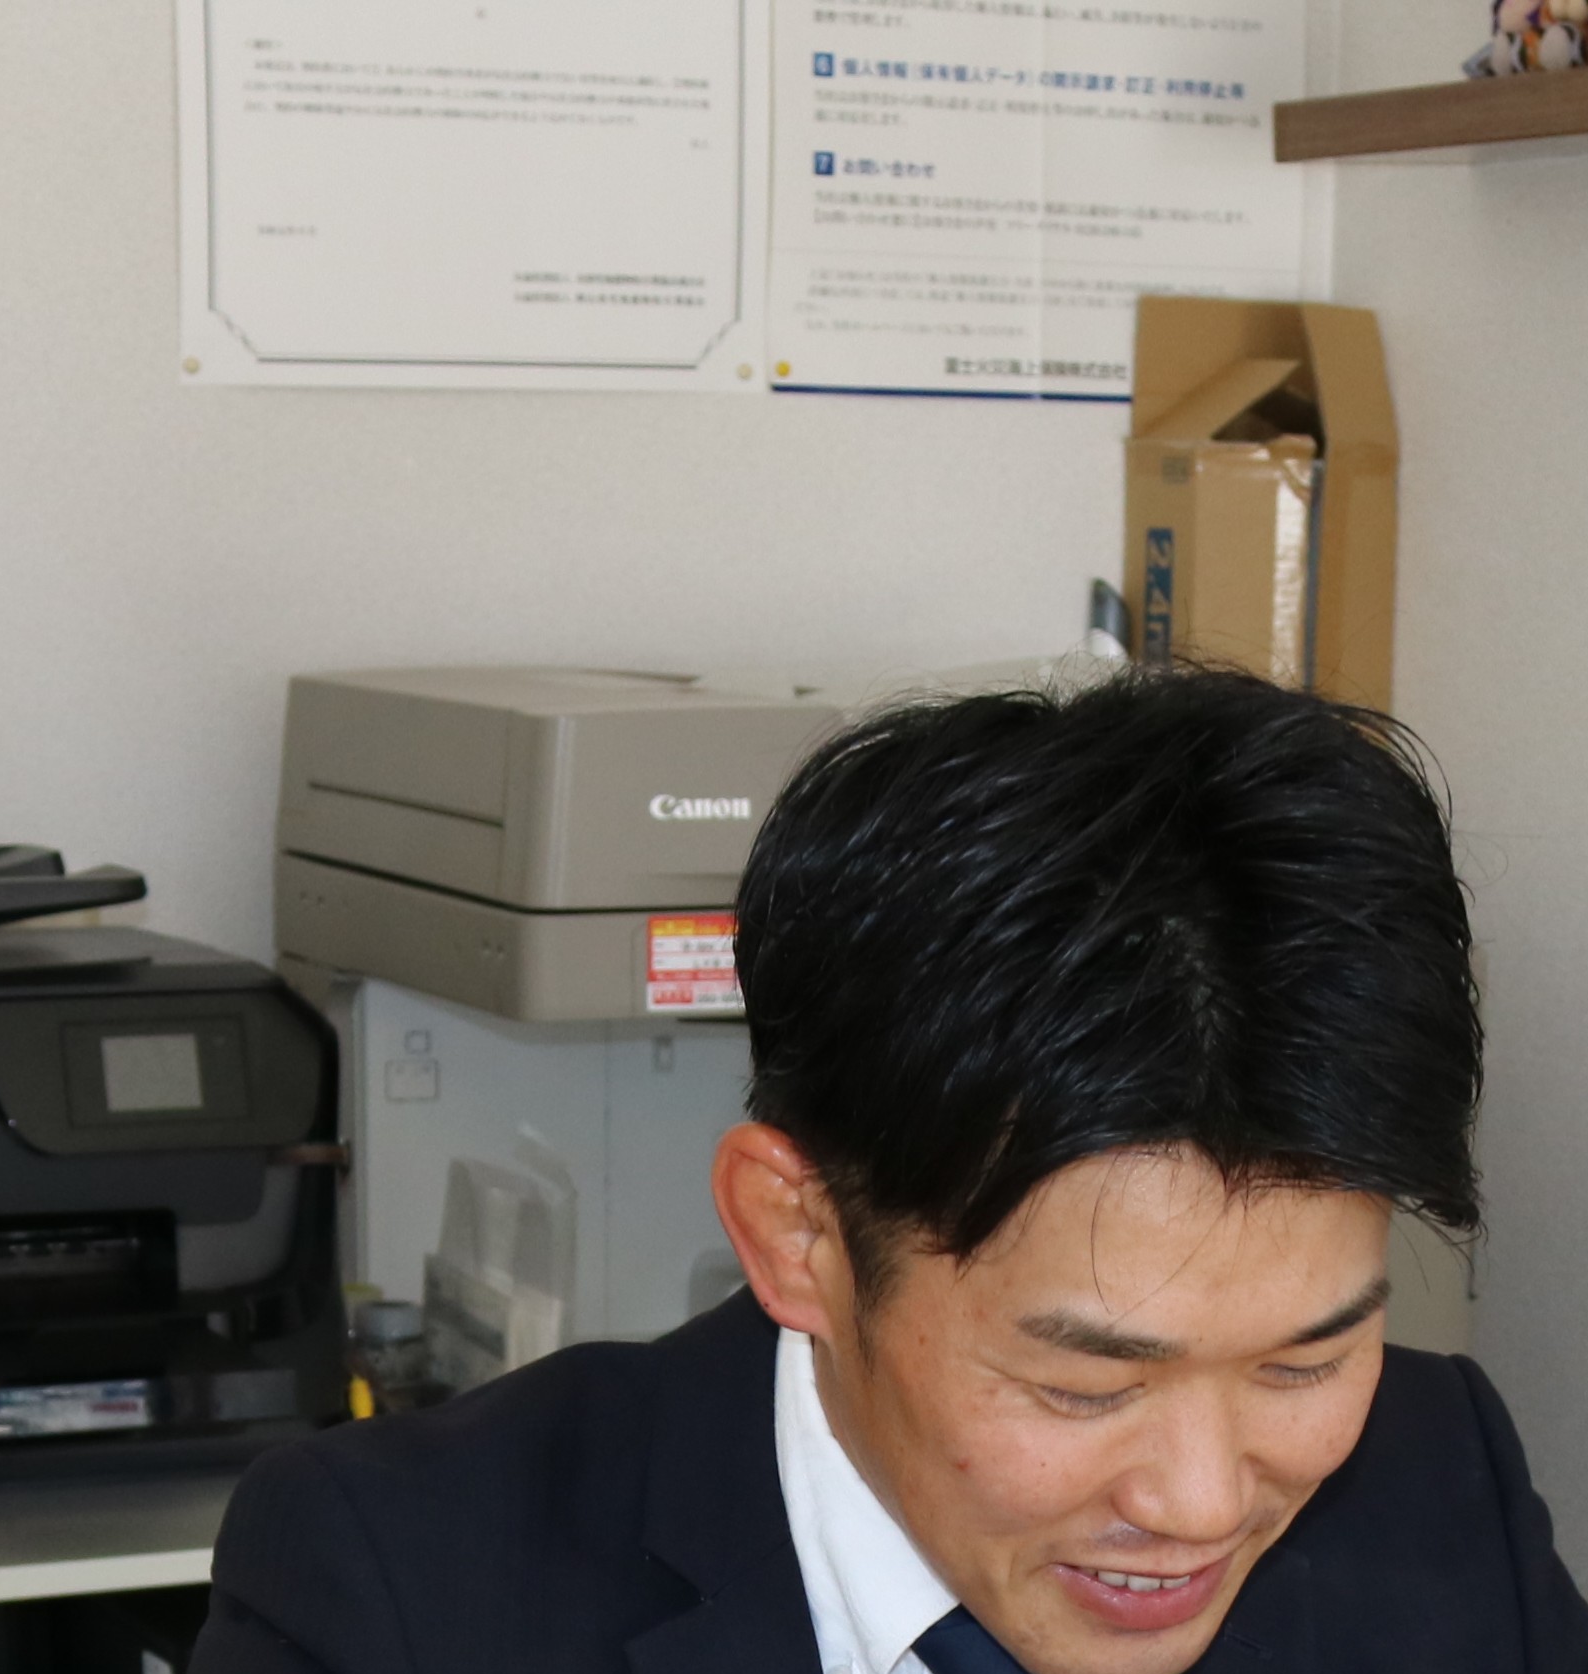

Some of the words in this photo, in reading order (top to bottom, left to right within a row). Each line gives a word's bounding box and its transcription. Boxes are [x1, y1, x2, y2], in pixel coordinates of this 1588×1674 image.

[842, 158, 936, 179] お問い合わせ
[649, 794, 751, 820] Canon
